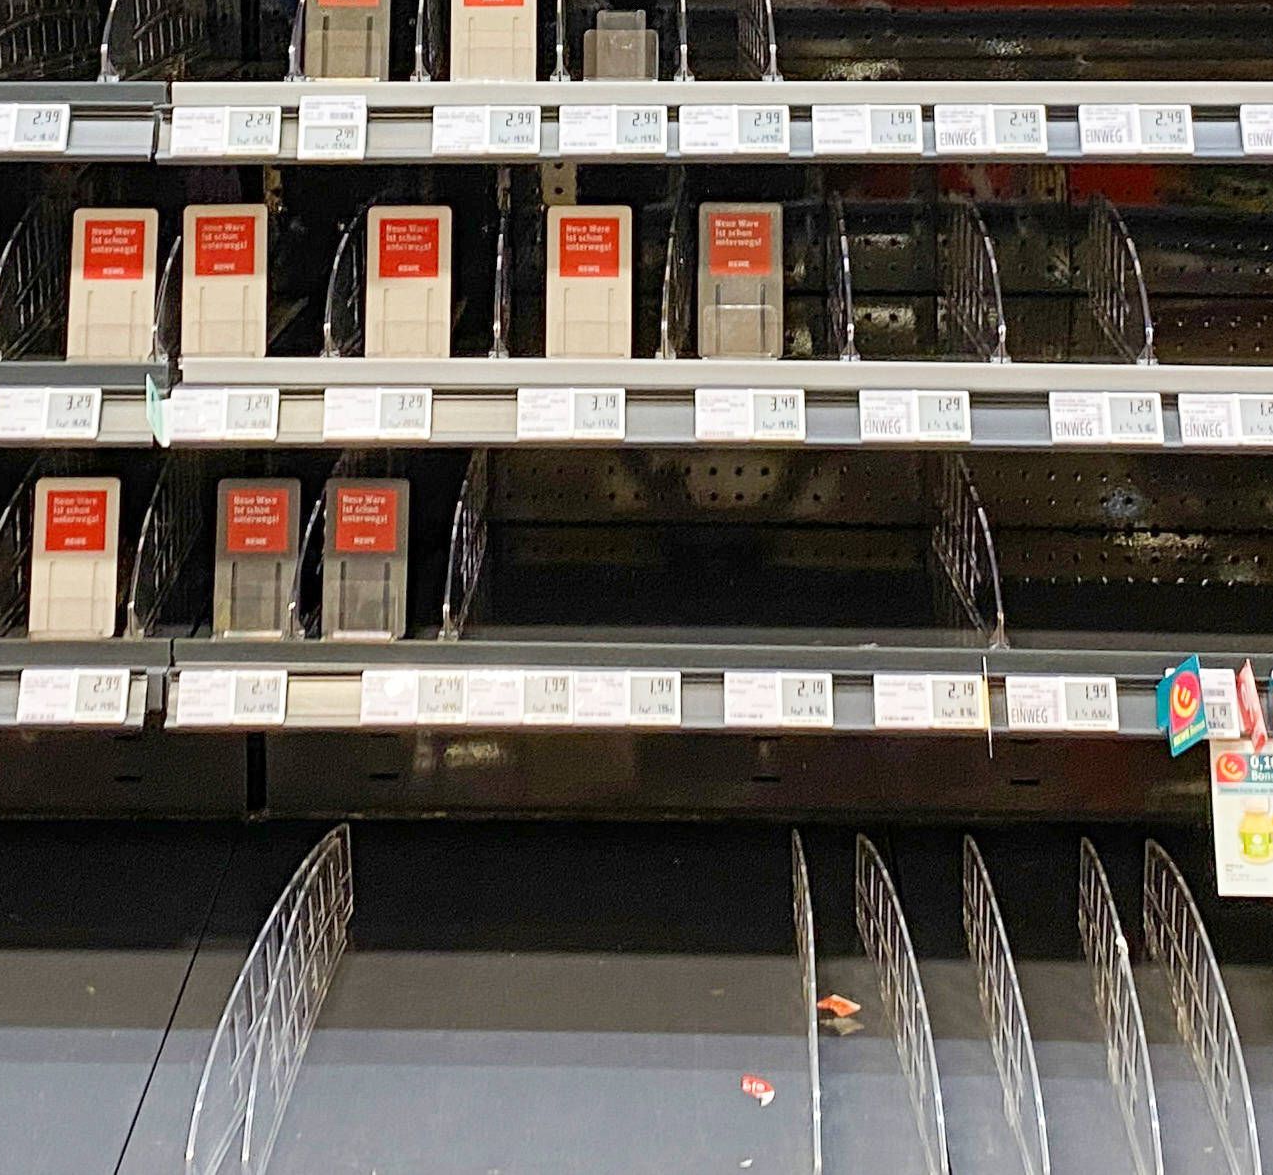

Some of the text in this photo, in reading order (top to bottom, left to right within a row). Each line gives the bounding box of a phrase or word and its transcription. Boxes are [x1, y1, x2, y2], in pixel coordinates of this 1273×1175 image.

[1086, 129, 1123, 143] EINWEG
[864, 419, 901, 434] EINWEG
[1056, 421, 1092, 436] EINWEG
[1011, 707, 1048, 723] EINWEG
